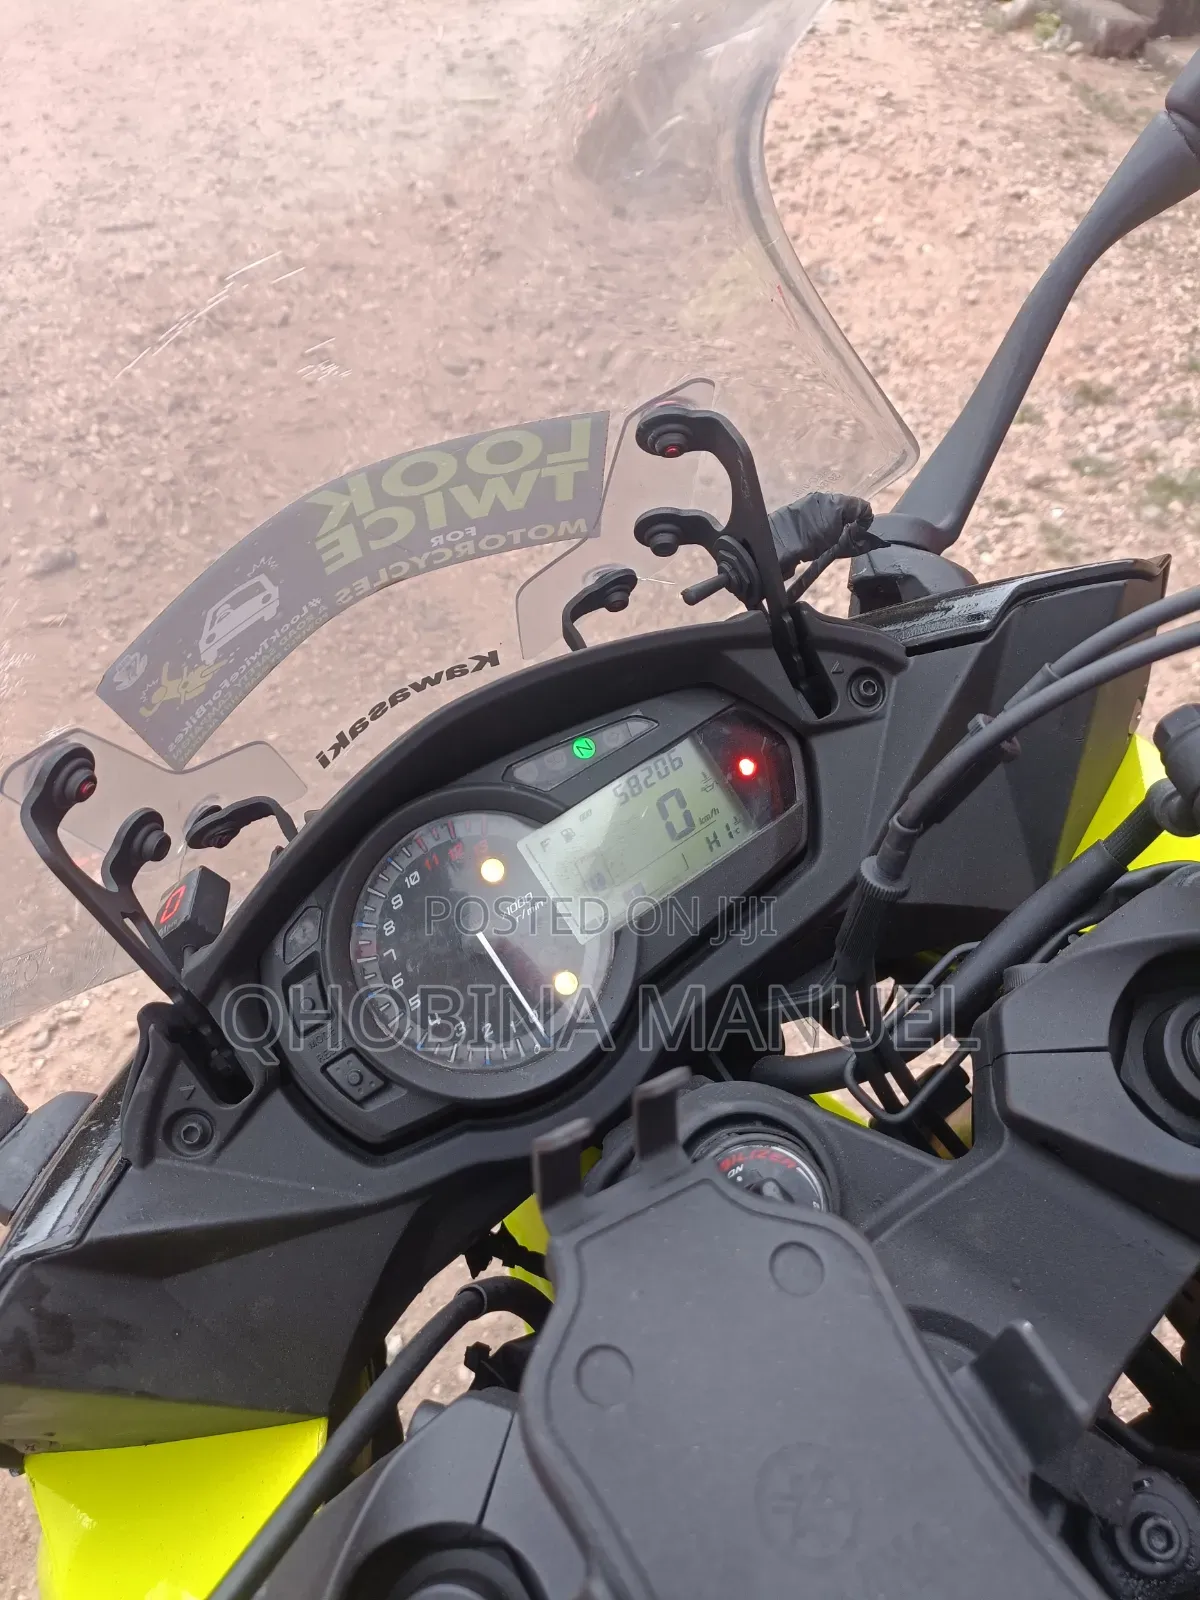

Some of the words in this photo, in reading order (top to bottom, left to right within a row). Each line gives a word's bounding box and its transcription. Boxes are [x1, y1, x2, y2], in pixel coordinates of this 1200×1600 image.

[575, 740, 593, 757] N
[613, 749, 684, 806] 58206
[656, 788, 696, 842] 0
[698, 807, 720, 826] km/h
[425, 853, 440, 871] 11
[405, 870, 421, 889] 10
[391, 893, 404, 910] 9
[383, 919, 396, 936] 8
[383, 948, 397, 961] 7
[391, 972, 404, 989] 6
[408, 993, 421, 1011] 5
[428, 1012, 441, 1026] 4
[454, 1021, 466, 1037] 3
[482, 1022, 494, 1038] 2
[727, 1163, 744, 1179] ON
